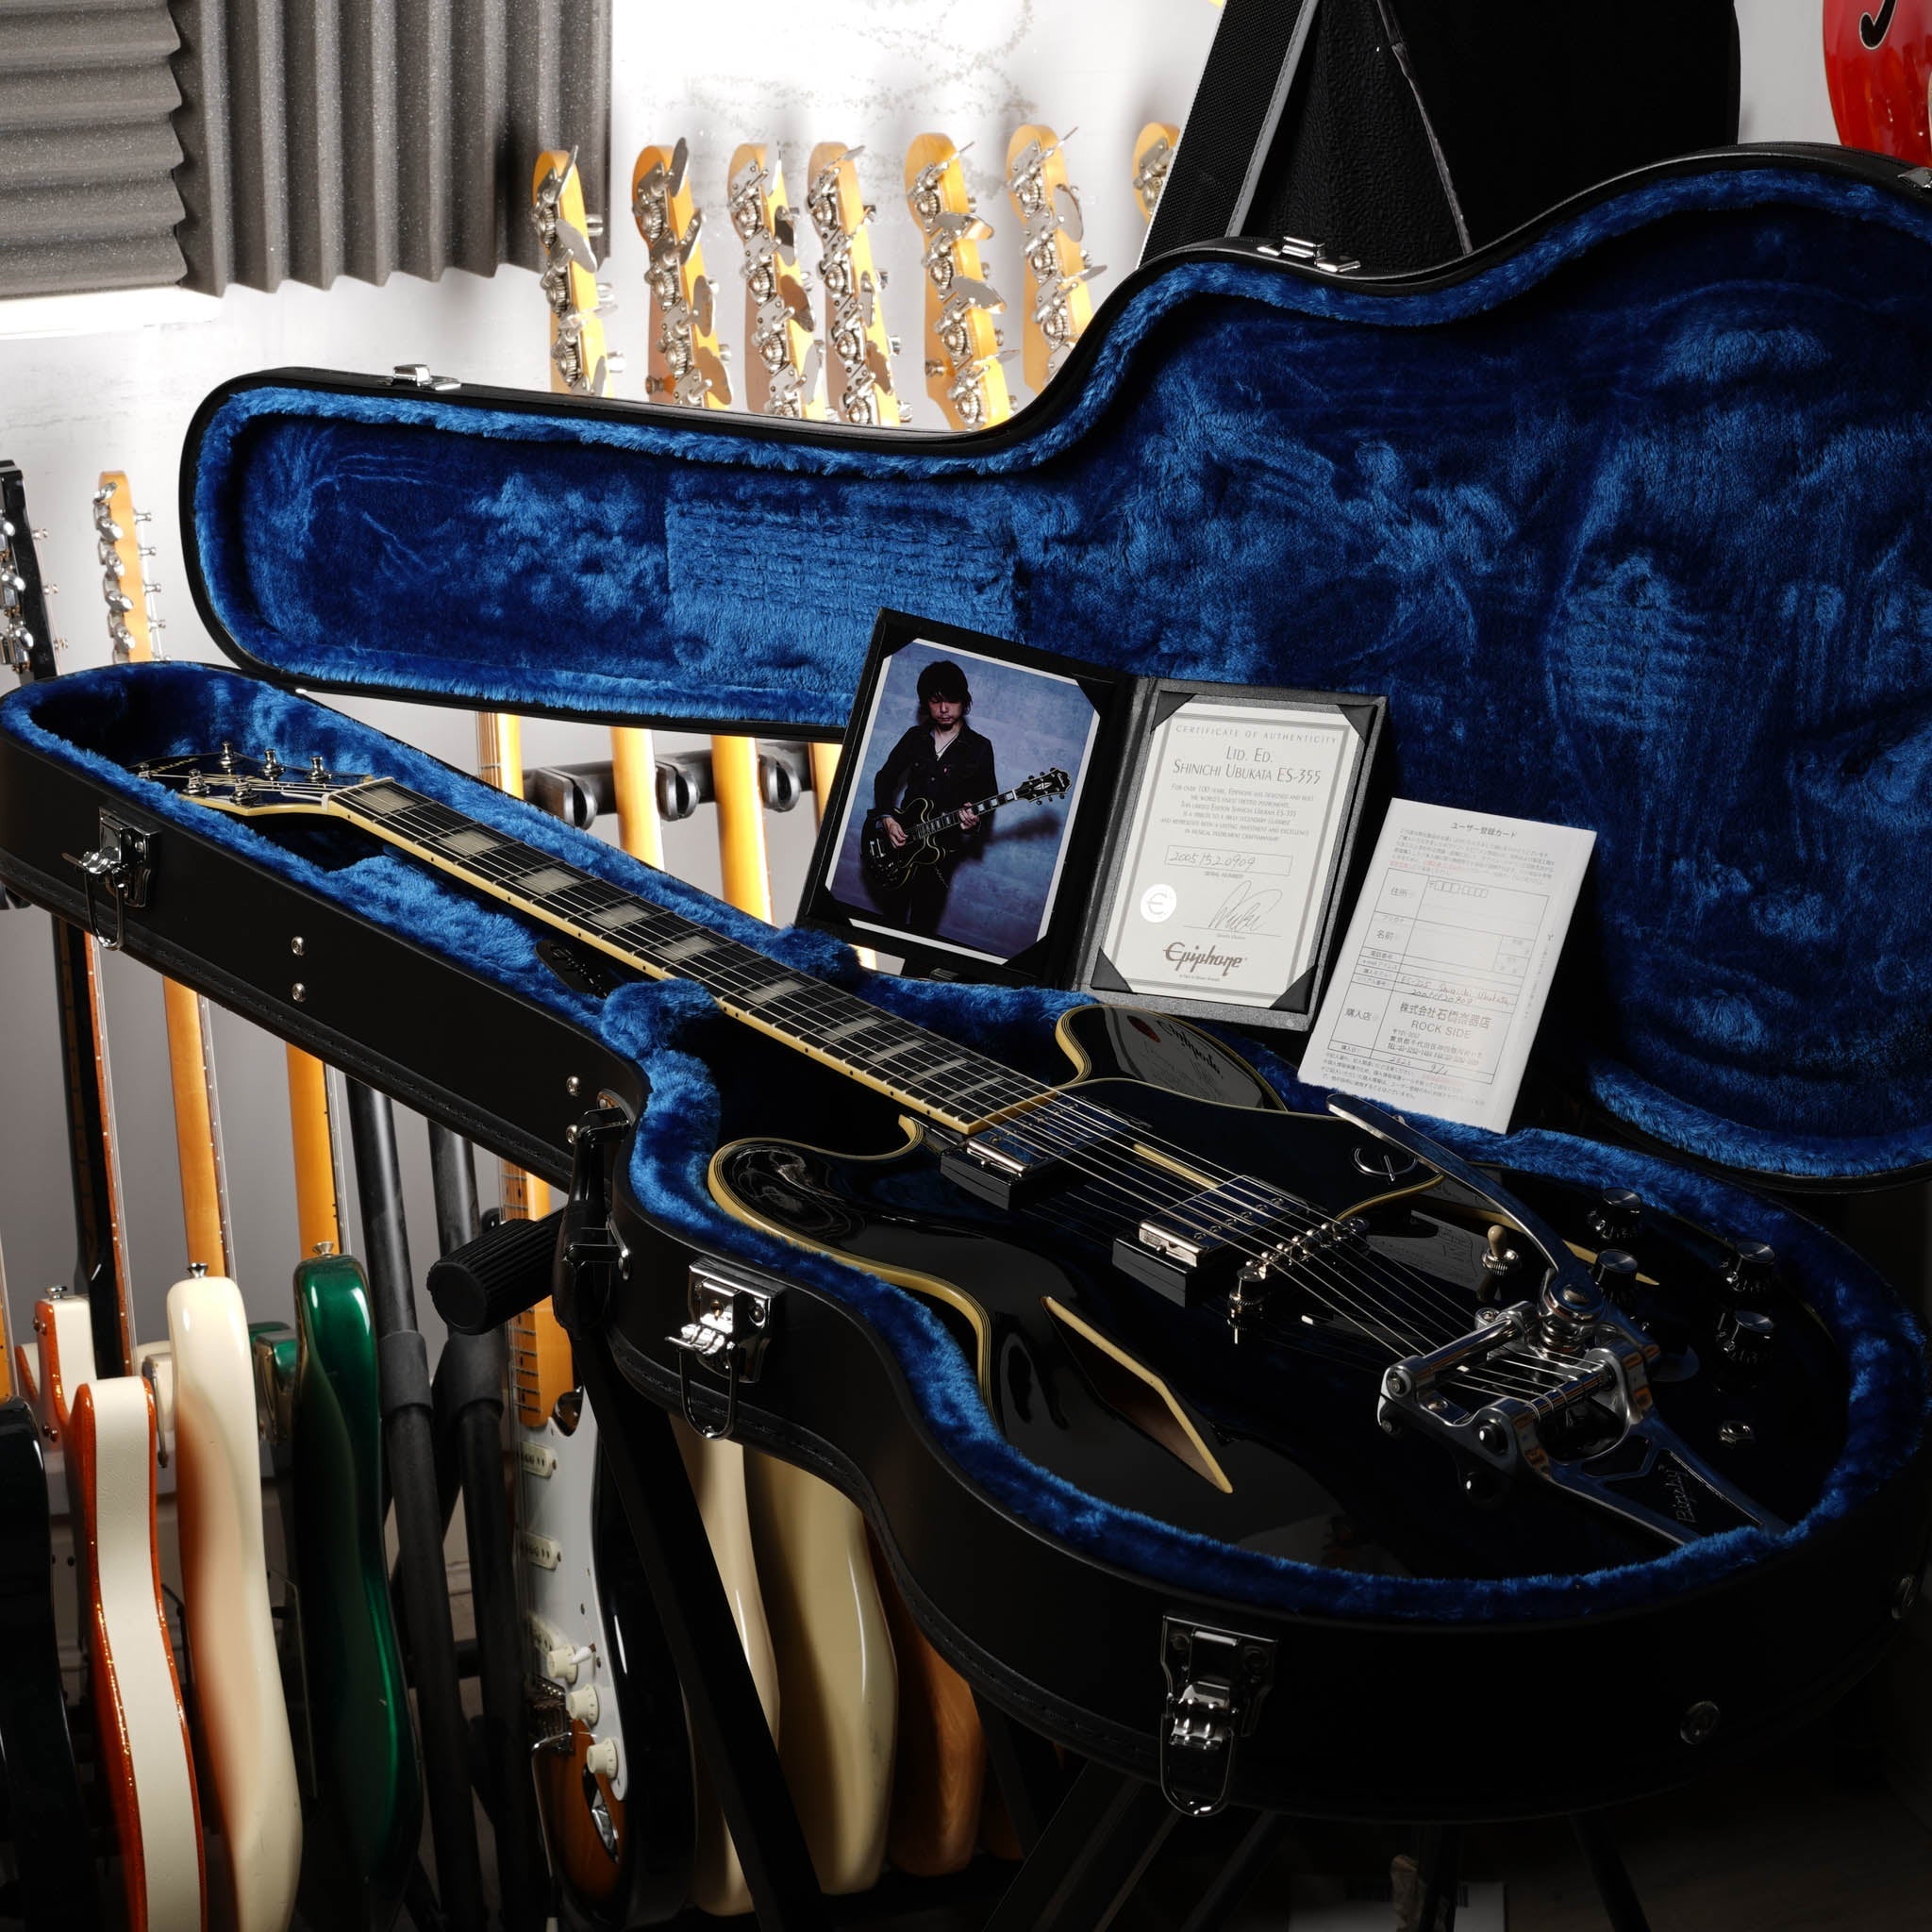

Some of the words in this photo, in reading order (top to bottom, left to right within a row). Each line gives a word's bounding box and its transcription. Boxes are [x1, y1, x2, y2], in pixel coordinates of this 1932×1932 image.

[1175, 725, 1239, 738] CERTIFICATE
[1263, 732, 1337, 744] AUTHENTICITY
[1254, 748, 1274, 763] ED.
[1226, 763, 1273, 782] UBUKATA
[1276, 767, 1322, 785] ES-355
[1376, 929, 1394, 941] 名前
[1163, 942, 1243, 976] Epiphone
[1411, 1020, 1442, 1034] ROCK
[1444, 1025, 1472, 1040] SIDE
